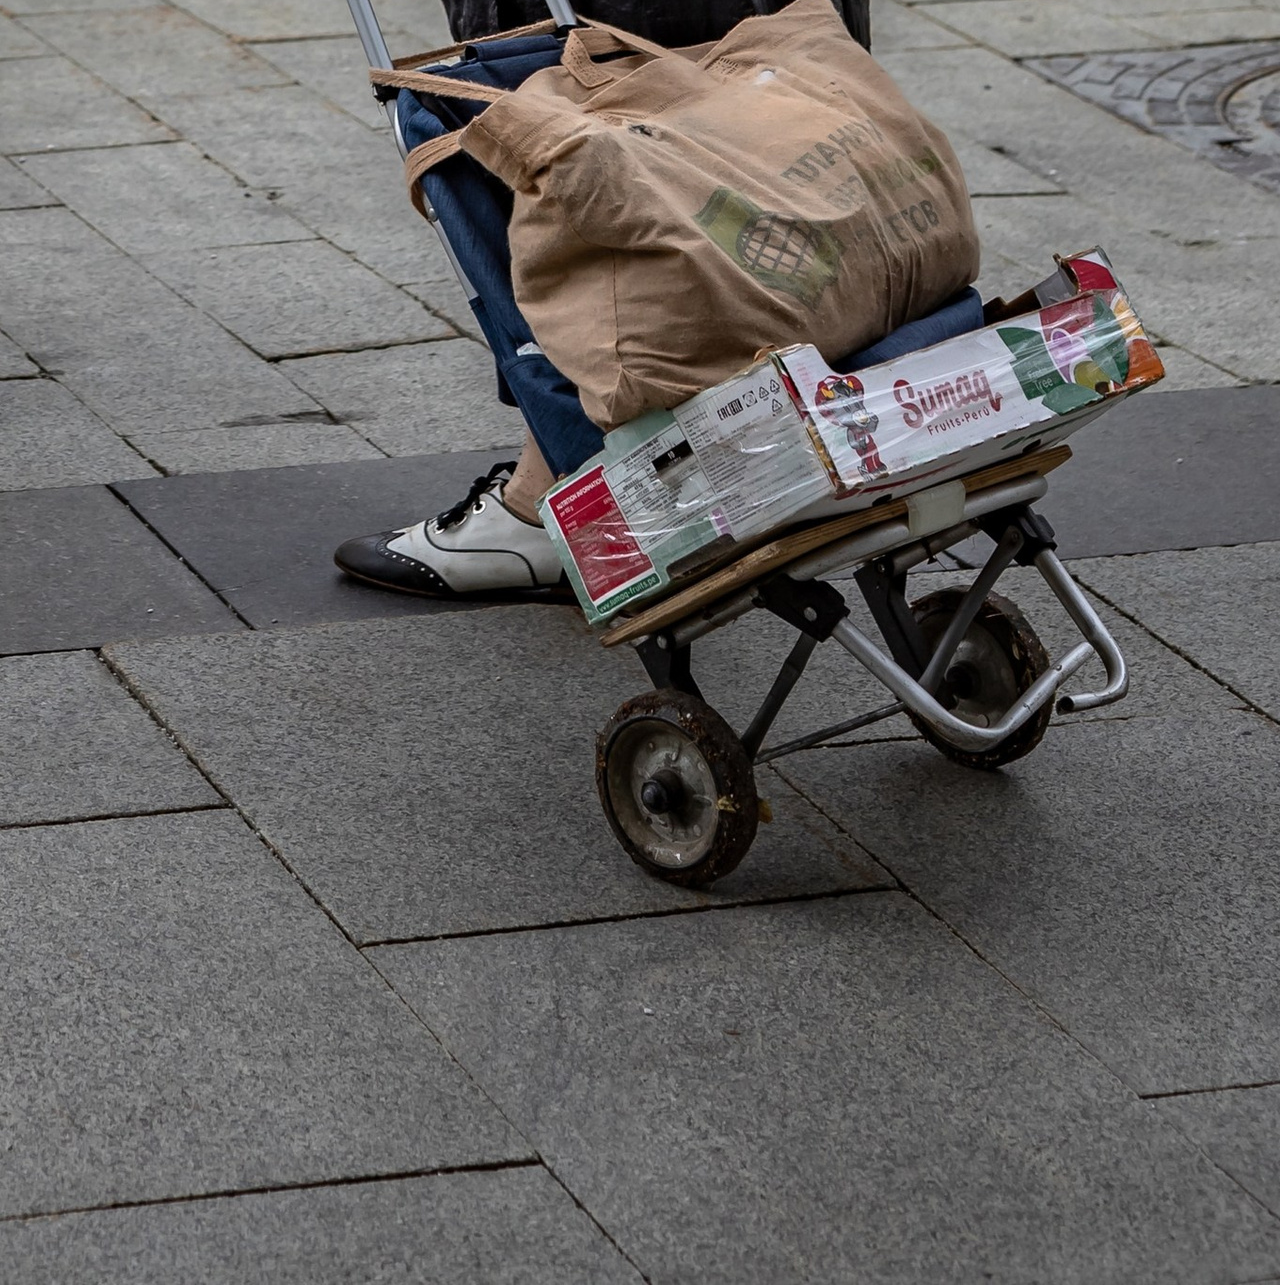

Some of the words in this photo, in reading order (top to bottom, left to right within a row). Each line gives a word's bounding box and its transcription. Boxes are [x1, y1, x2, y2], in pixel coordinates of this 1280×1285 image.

[892, 369, 1004, 429] Sumaq
[555, 492, 578, 511] NUTRITION
[576, 477, 604, 498] INFORMATION
